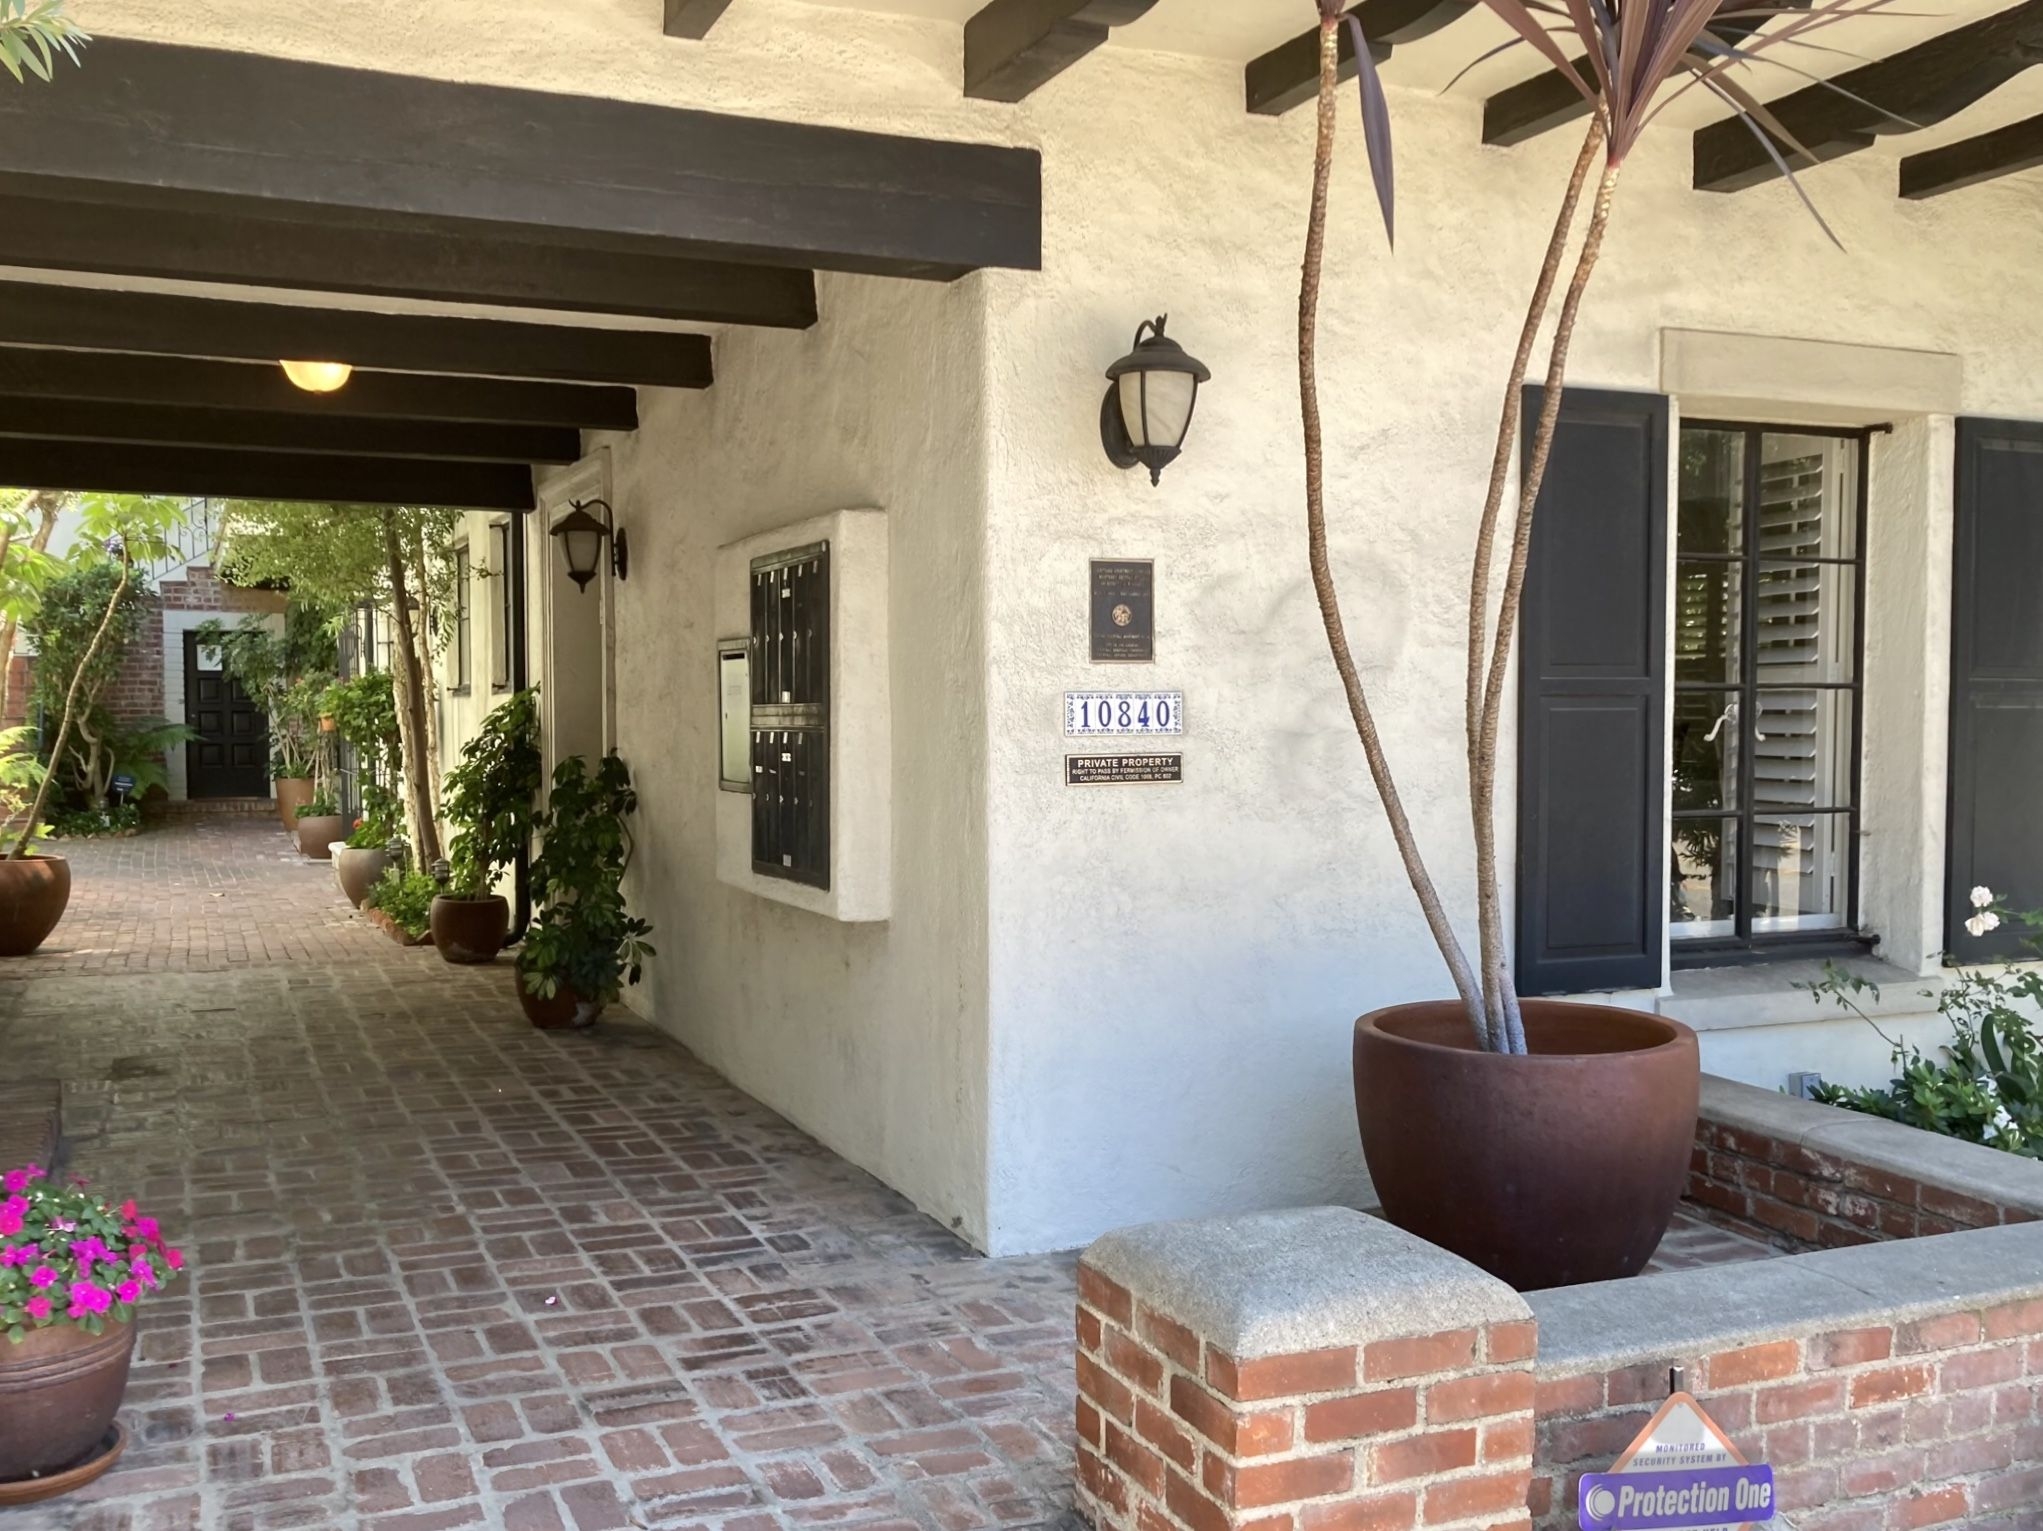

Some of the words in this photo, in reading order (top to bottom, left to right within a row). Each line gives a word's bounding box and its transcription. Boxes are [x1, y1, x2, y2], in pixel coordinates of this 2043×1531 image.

[1081, 700, 1170, 727] 10840
[1078, 759, 1119, 767] PRIVATE
[1122, 757, 1174, 767] PROPERTY
[1656, 1443, 1706, 1453] MONITORED
[1633, 1457, 1677, 1467] SECURITY
[1679, 1454, 1713, 1465] SYSTEM
[1716, 1453, 1727, 1462] BY
[1618, 1481, 1730, 1518] Protection
[1735, 1477, 1771, 1511] One
